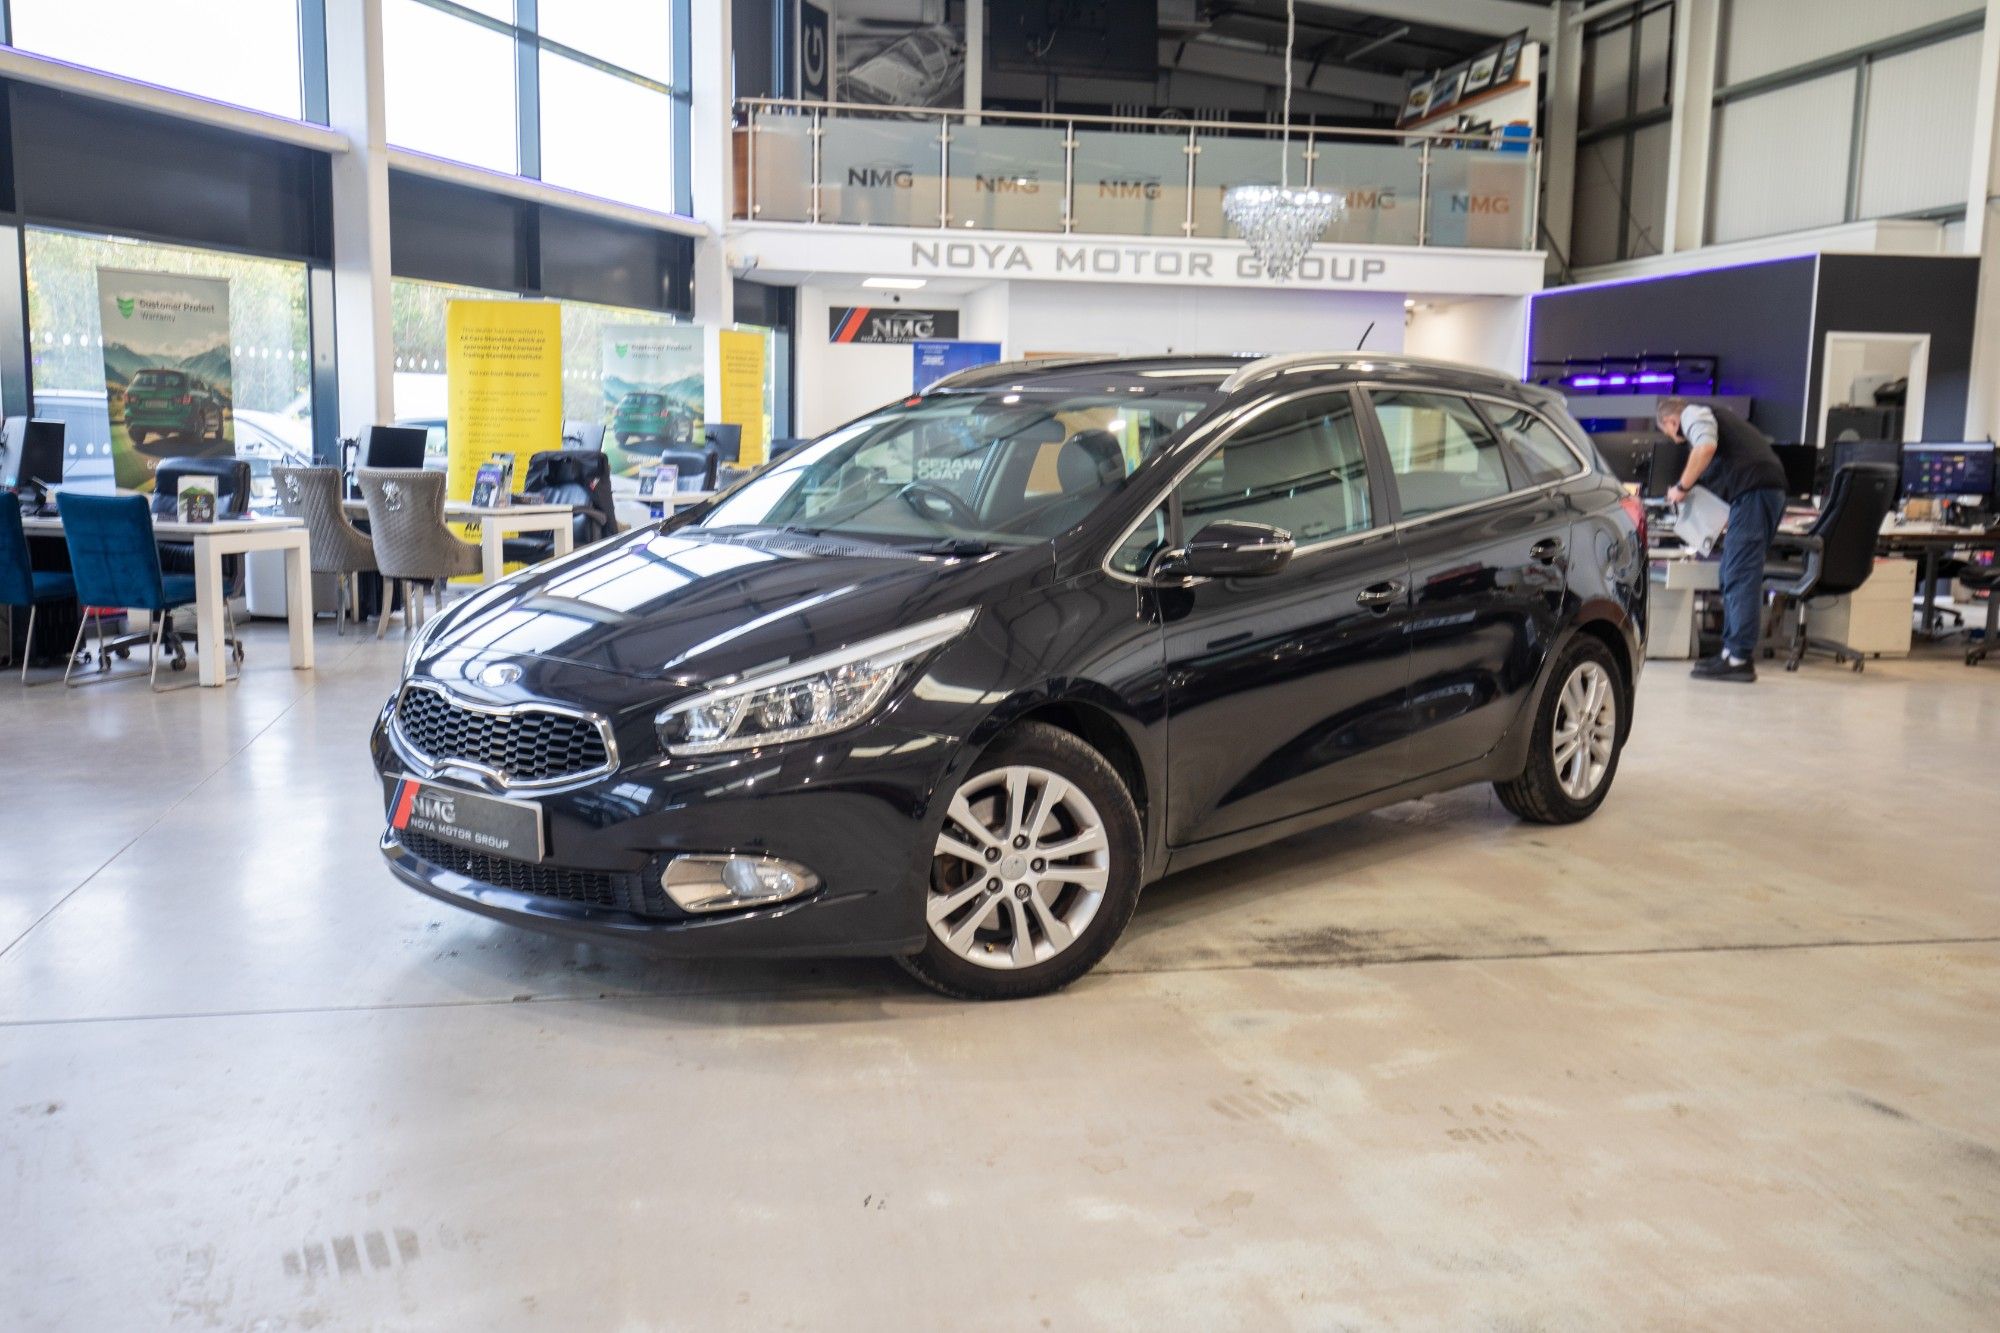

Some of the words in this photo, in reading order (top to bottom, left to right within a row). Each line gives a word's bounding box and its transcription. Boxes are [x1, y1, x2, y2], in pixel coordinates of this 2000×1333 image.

[848, 168, 913, 189] NMG
[975, 174, 1040, 194] NMG
[1099, 180, 1162, 200] NMG
[1451, 194, 1509, 214] NMG
[911, 241, 1033, 271] NOYA
[1056, 246, 1213, 278] MOTOR
[872, 318, 935, 338] NMG
[918, 457, 982, 471] CERAM
[410, 794, 456, 823] NMG
[411, 818, 435, 832] NOYA
[439, 824, 472, 841] MOTOR
[475, 832, 509, 849] GROUP
